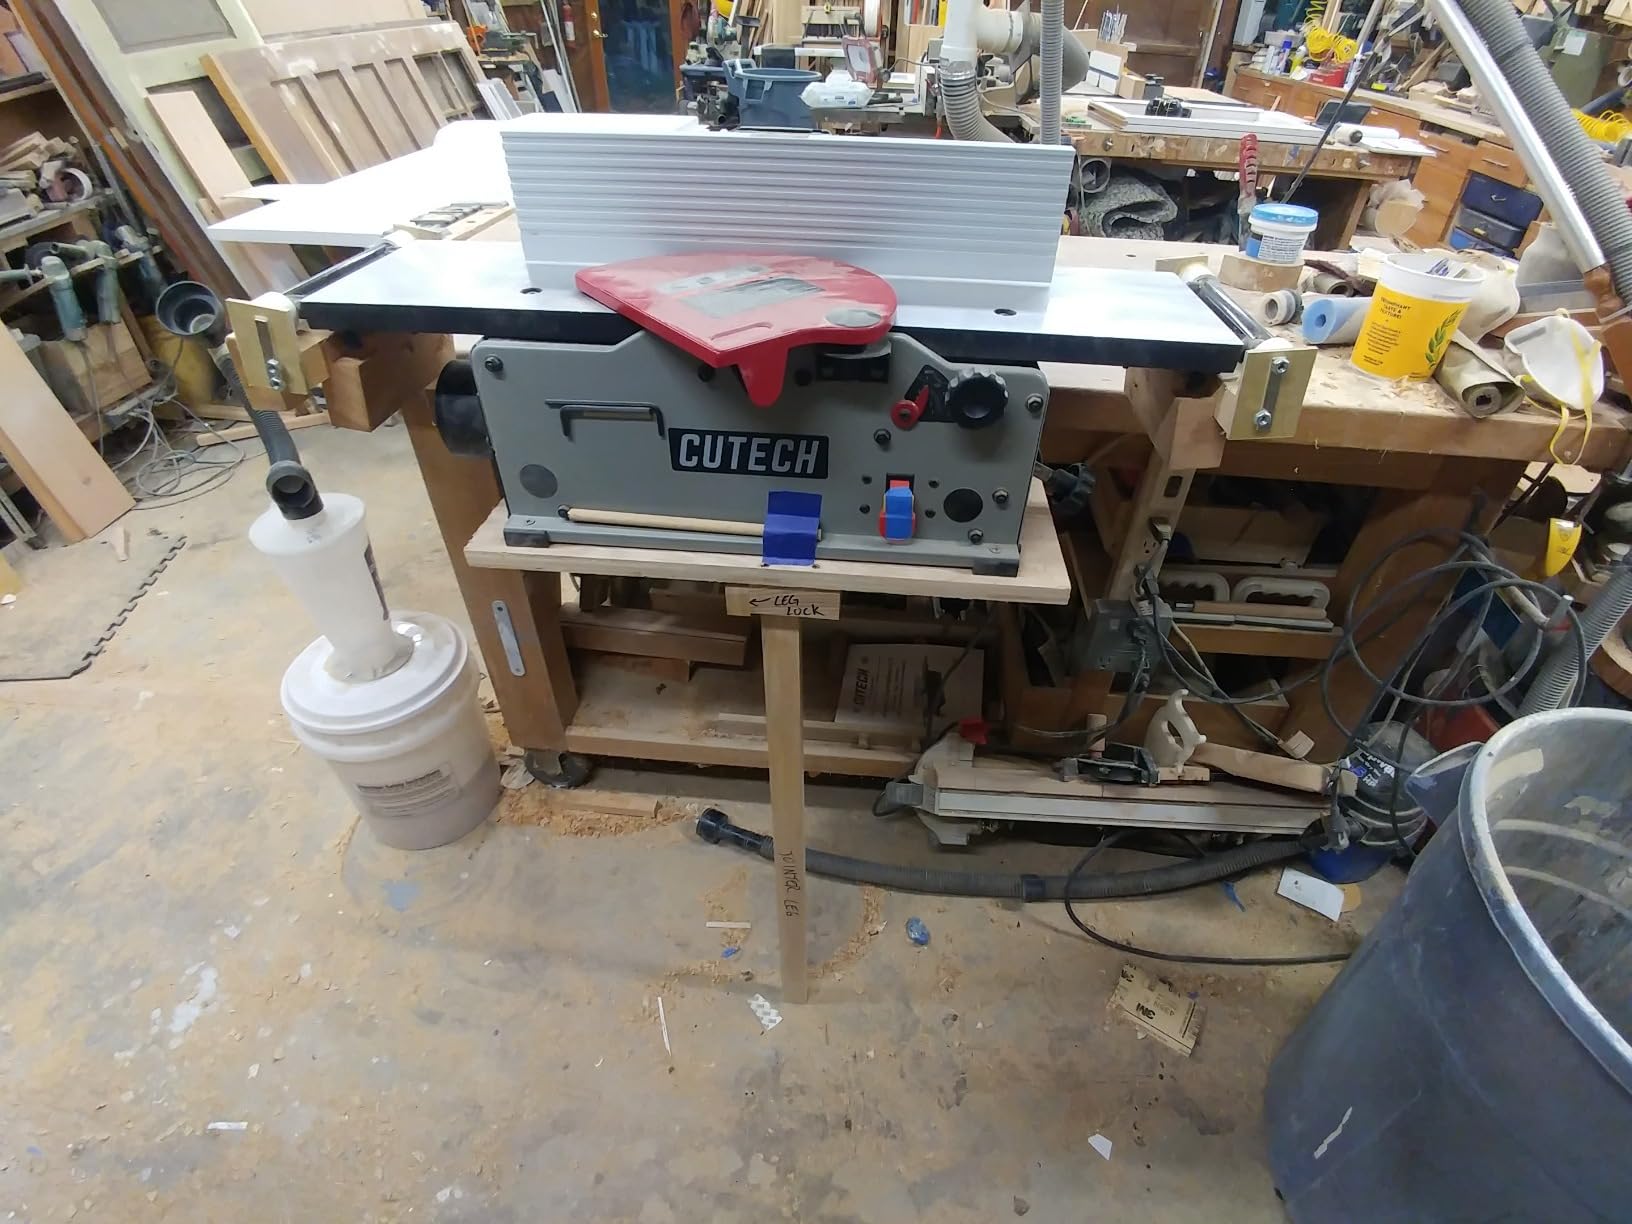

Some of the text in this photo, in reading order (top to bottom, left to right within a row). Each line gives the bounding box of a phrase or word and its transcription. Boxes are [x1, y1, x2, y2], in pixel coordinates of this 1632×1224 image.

[679, 433, 820, 475] CUTECH
[774, 594, 799, 606] LEG
[786, 604, 824, 617] LOCK
[1136, 1003, 1156, 1020] 3M
